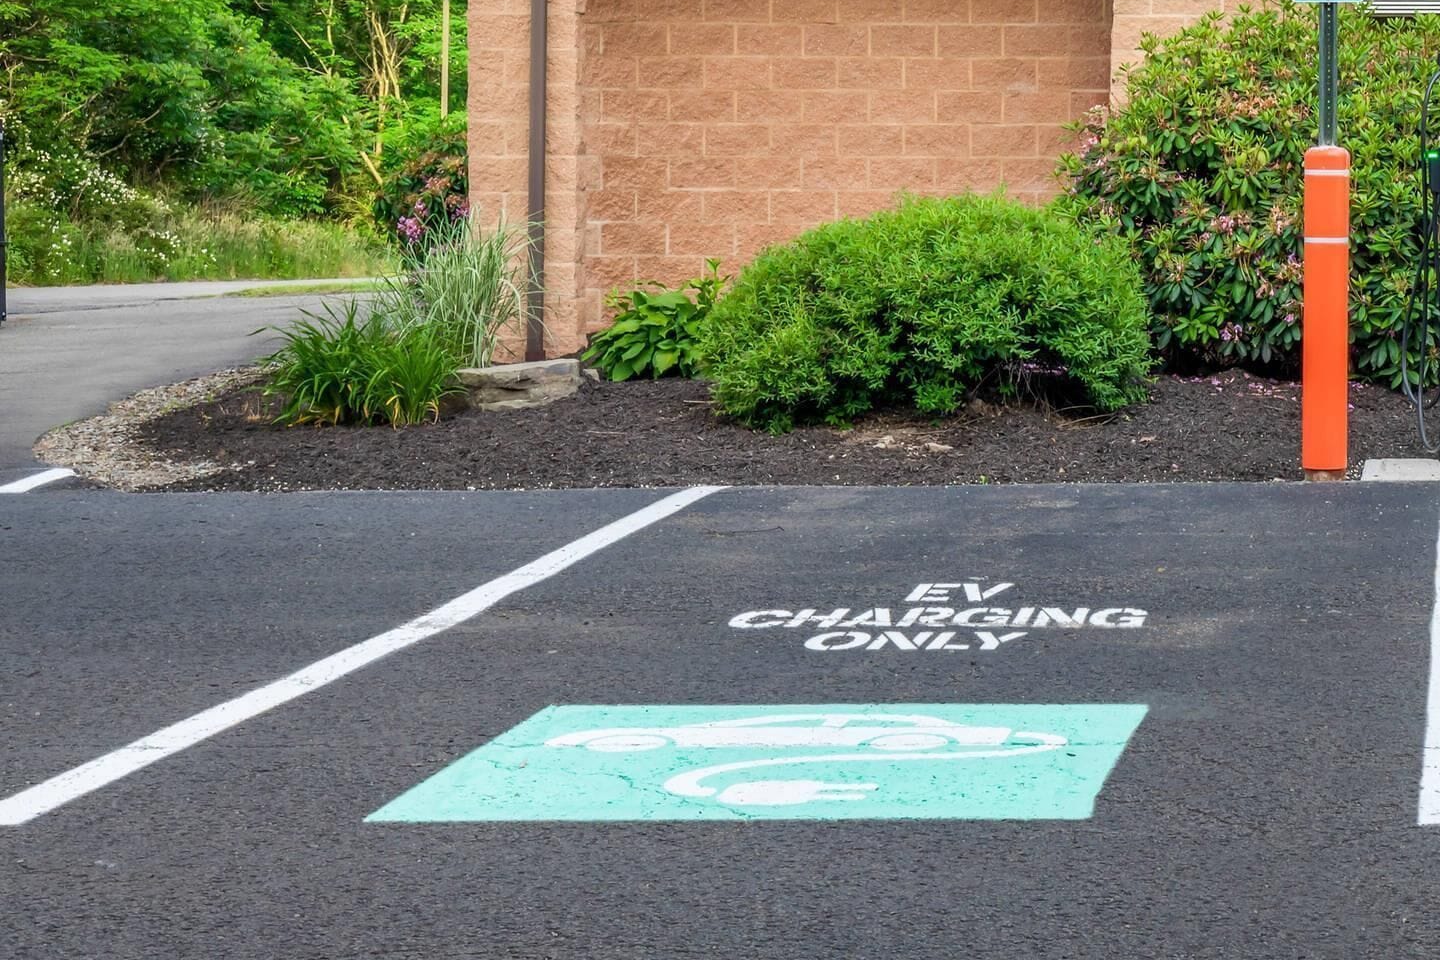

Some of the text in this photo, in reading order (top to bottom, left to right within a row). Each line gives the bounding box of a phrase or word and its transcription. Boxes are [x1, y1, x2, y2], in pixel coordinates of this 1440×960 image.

[904, 582, 1015, 603] EV
[728, 606, 1149, 629] CHARGING
[803, 630, 1029, 651] ONLY
